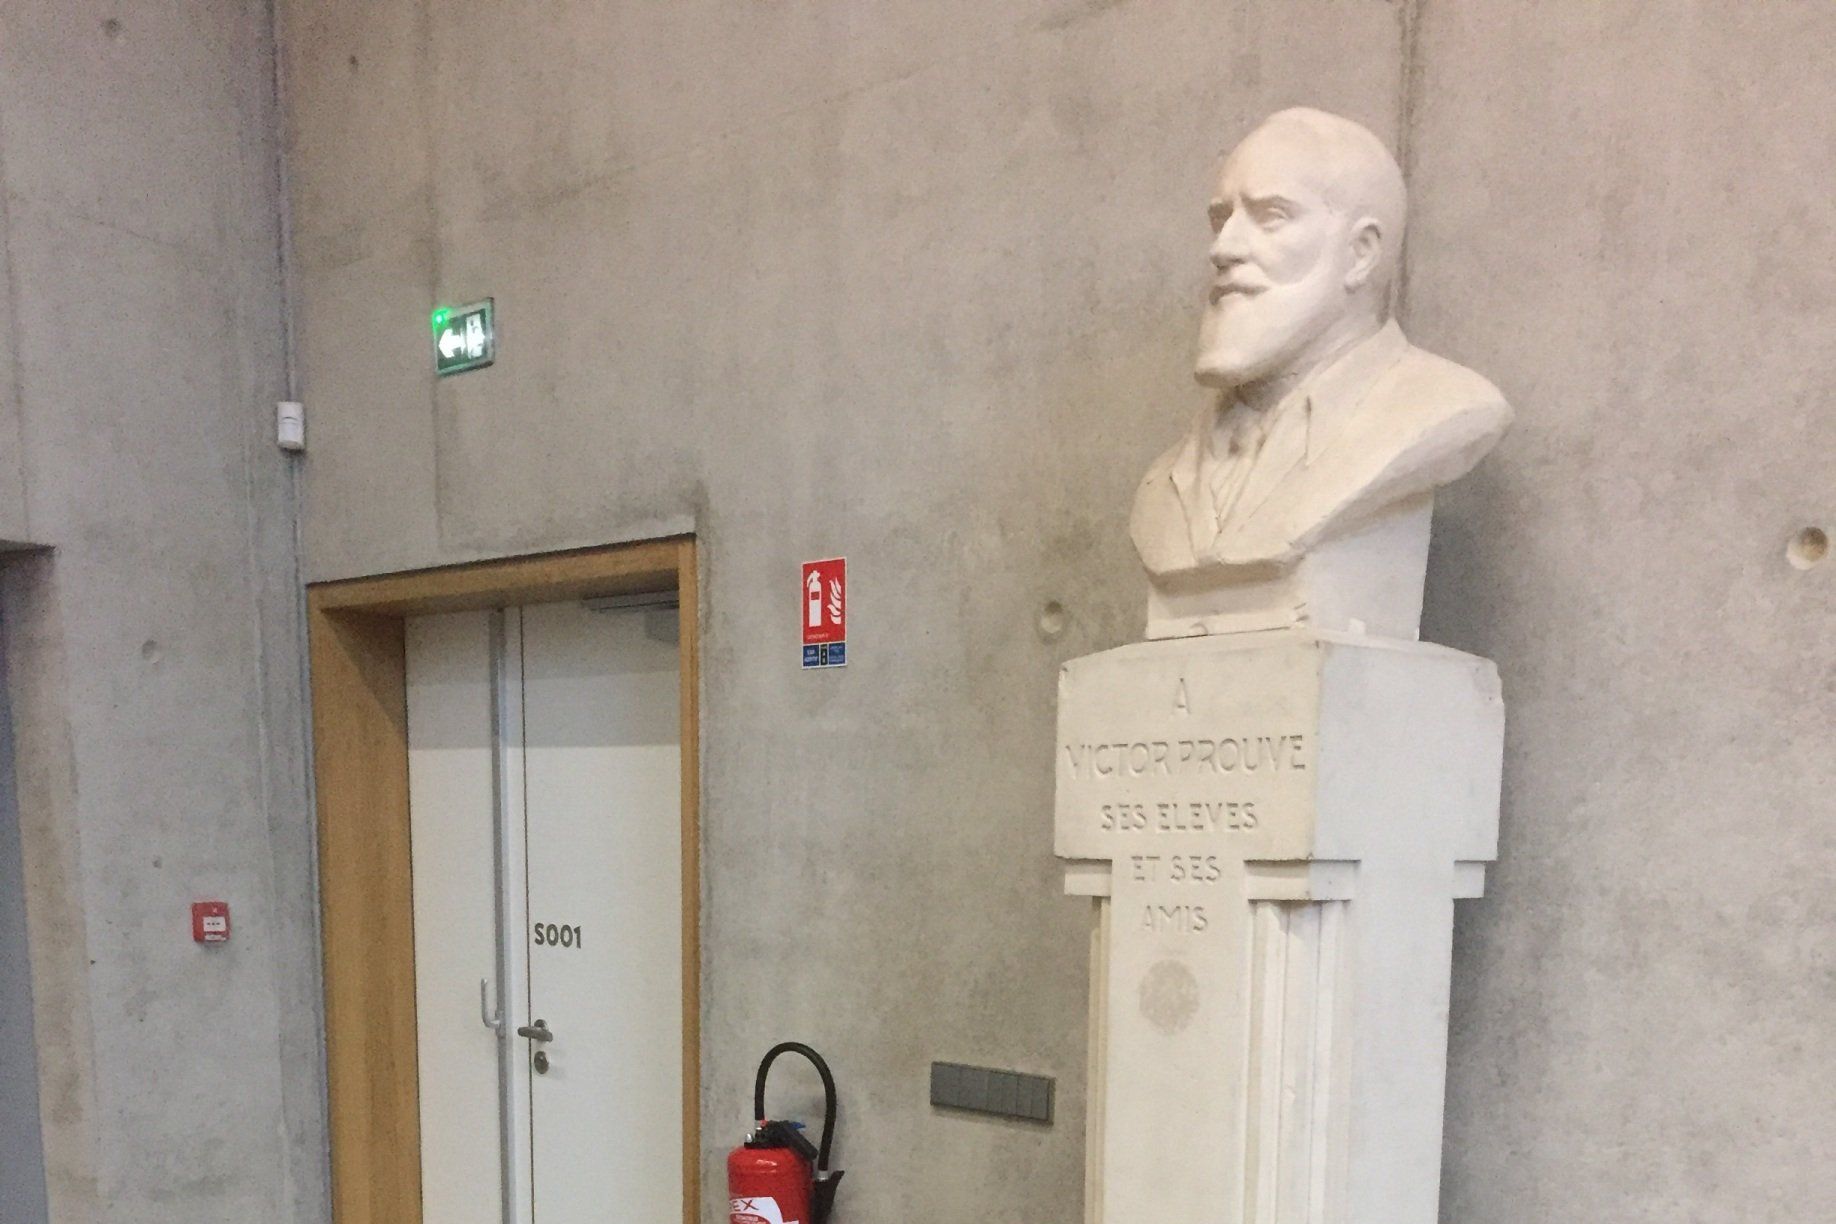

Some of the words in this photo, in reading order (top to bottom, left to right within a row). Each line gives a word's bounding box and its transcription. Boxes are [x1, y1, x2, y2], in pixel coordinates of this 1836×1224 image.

[1172, 676, 1192, 716] A
[1064, 741, 1172, 779] VICTOR
[1177, 734, 1306, 776] PROUVE
[1100, 803, 1148, 831] SES
[1156, 802, 1259, 831] ELEVES
[1130, 855, 1161, 882] ET
[1169, 855, 1222, 882] SES
[1141, 905, 1209, 933] AMIS
[534, 922, 581, 949] S001
